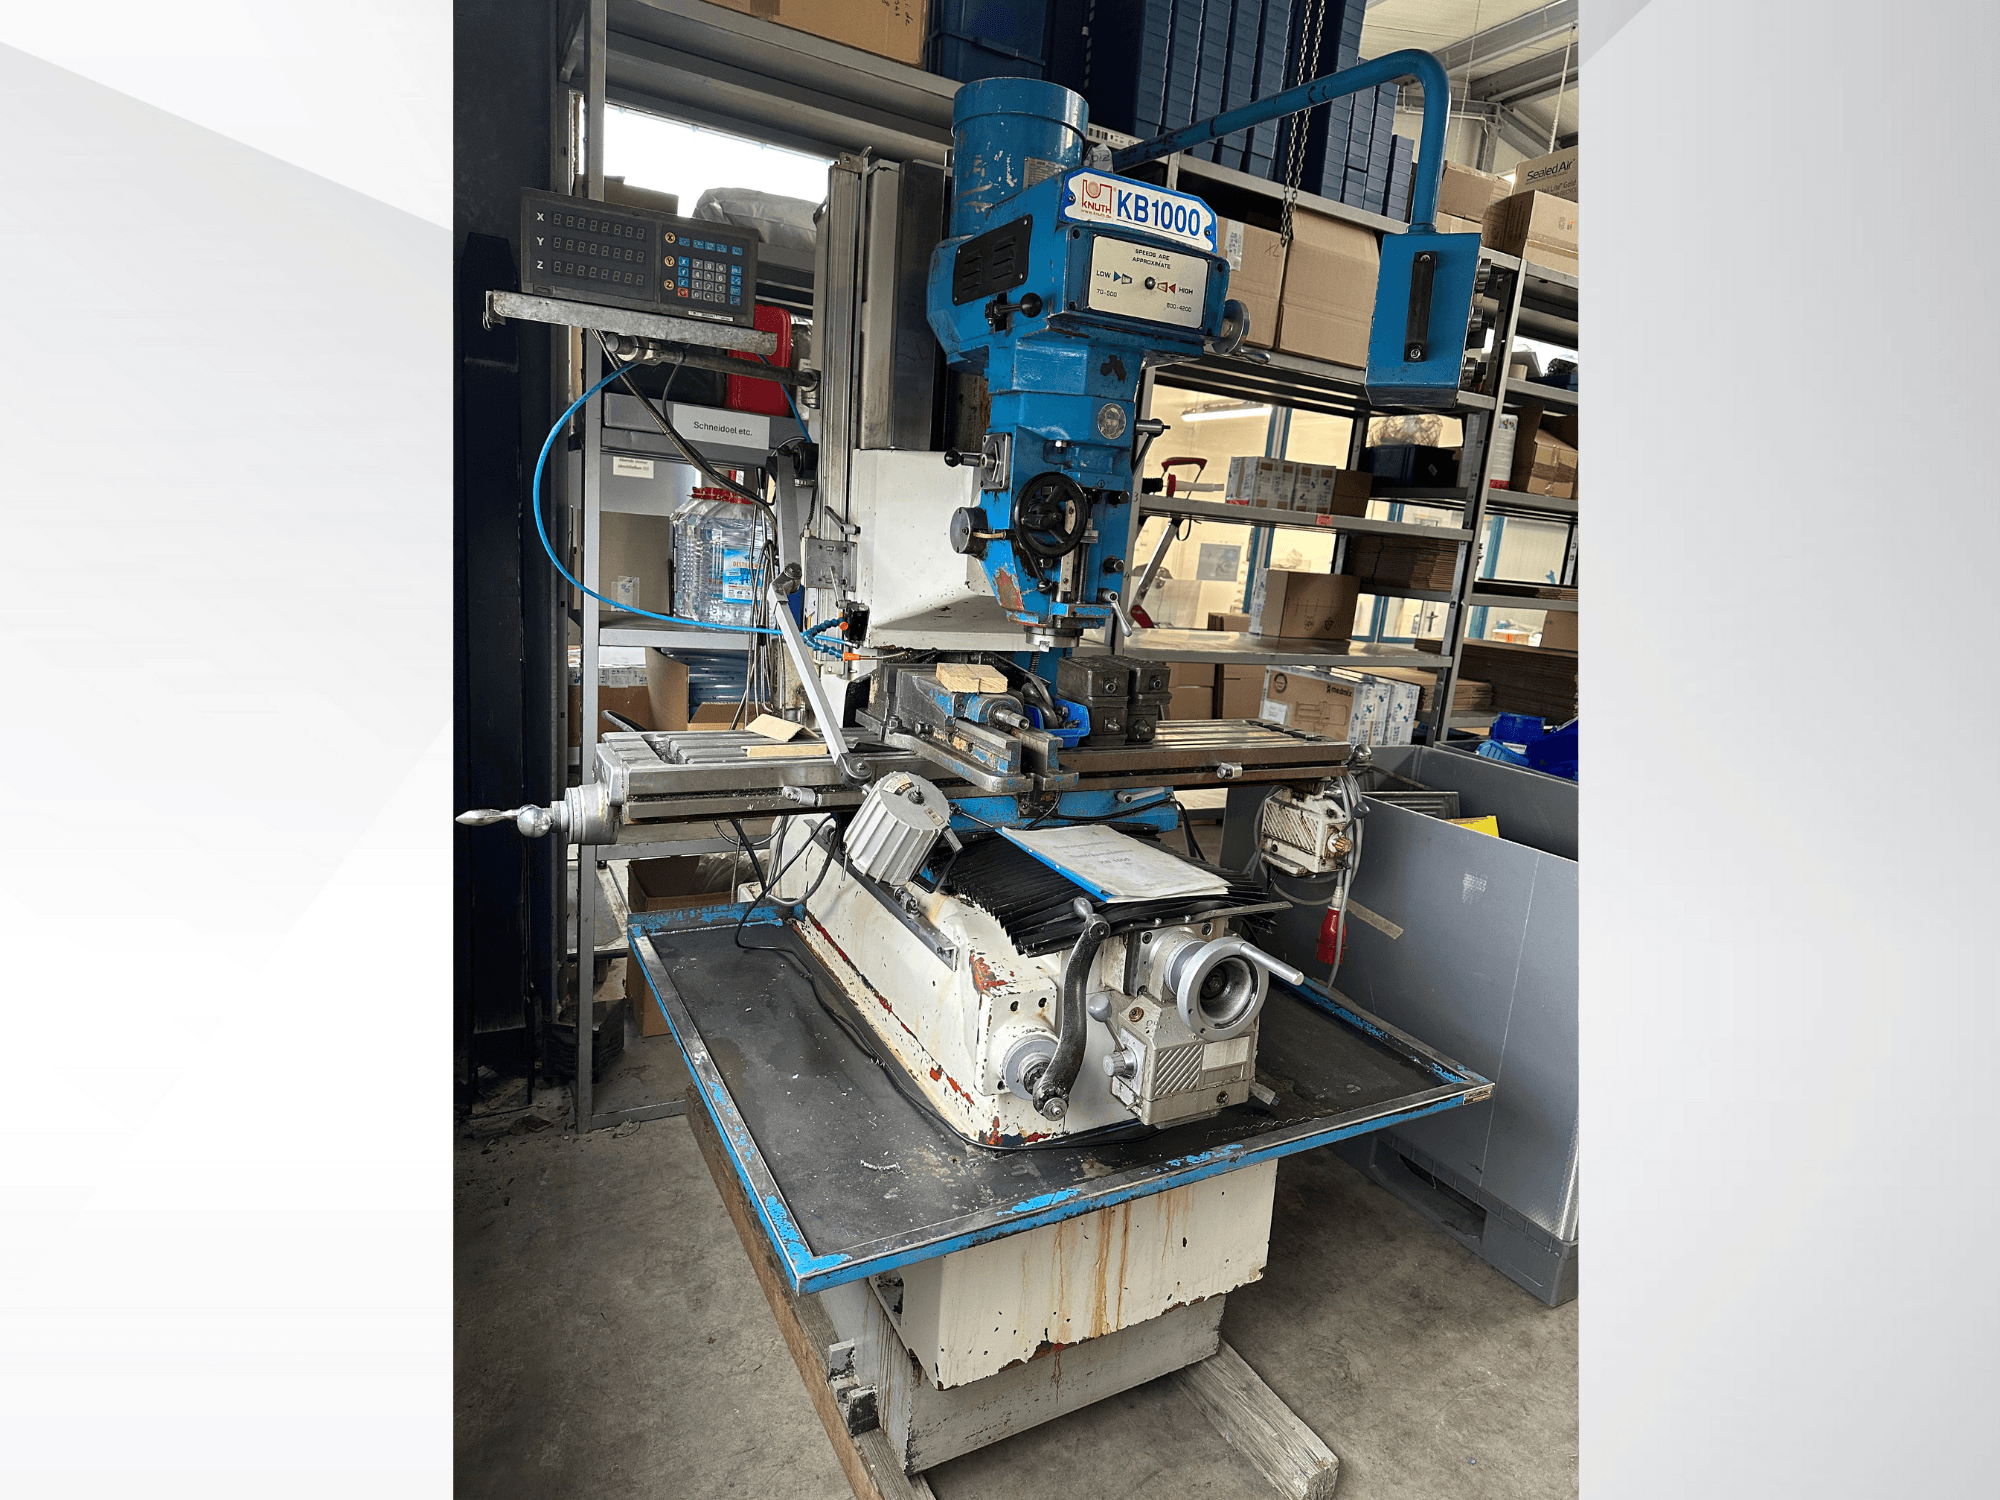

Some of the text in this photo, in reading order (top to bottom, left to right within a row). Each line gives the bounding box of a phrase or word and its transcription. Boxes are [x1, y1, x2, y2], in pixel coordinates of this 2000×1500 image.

[1527, 164, 1559, 181] Sealed
[1559, 161, 1572, 172] Air
[1082, 200, 1112, 214] KNUTH
[1117, 189, 1200, 237] KB1000
[536, 212, 545, 221] X
[536, 237, 545, 246] Y
[1135, 248, 1170, 261] SPEEDS ARE
[536, 261, 544, 269] Z
[1132, 256, 1171, 270] APPROXIMATE
[1096, 270, 1112, 279] LOW
[1178, 286, 1194, 295] HIGH
[693, 421, 753, 437] Schneidoel etc.
[1132, 491, 1139, 503] 3
[1123, 571, 1130, 581] 4
